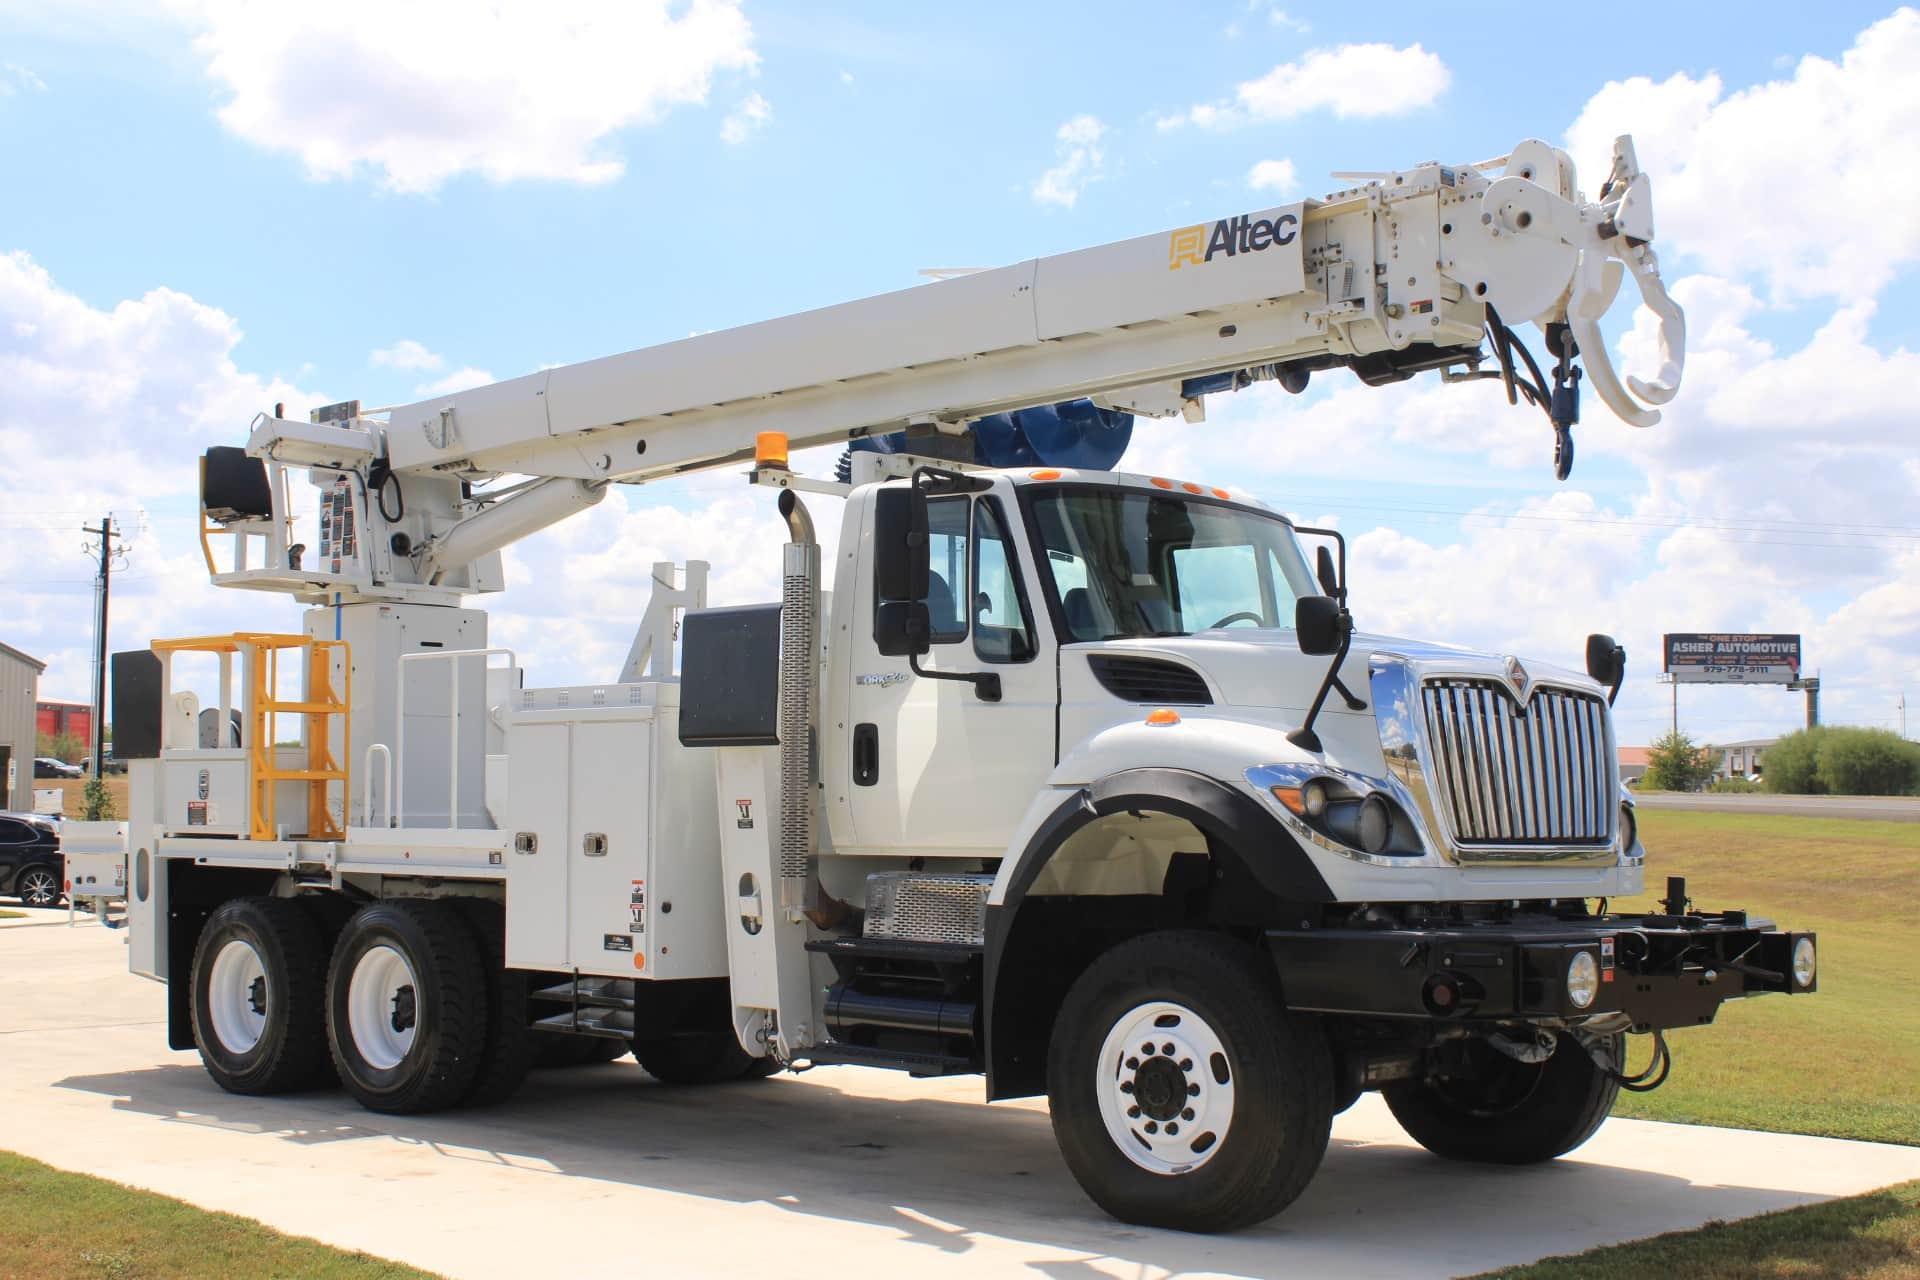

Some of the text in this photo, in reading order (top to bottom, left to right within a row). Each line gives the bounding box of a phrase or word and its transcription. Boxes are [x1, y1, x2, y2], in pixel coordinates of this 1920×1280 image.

[1204, 214, 1297, 262] Altec
[1672, 642, 1797, 653] ASHER AUTOMOTIVE
